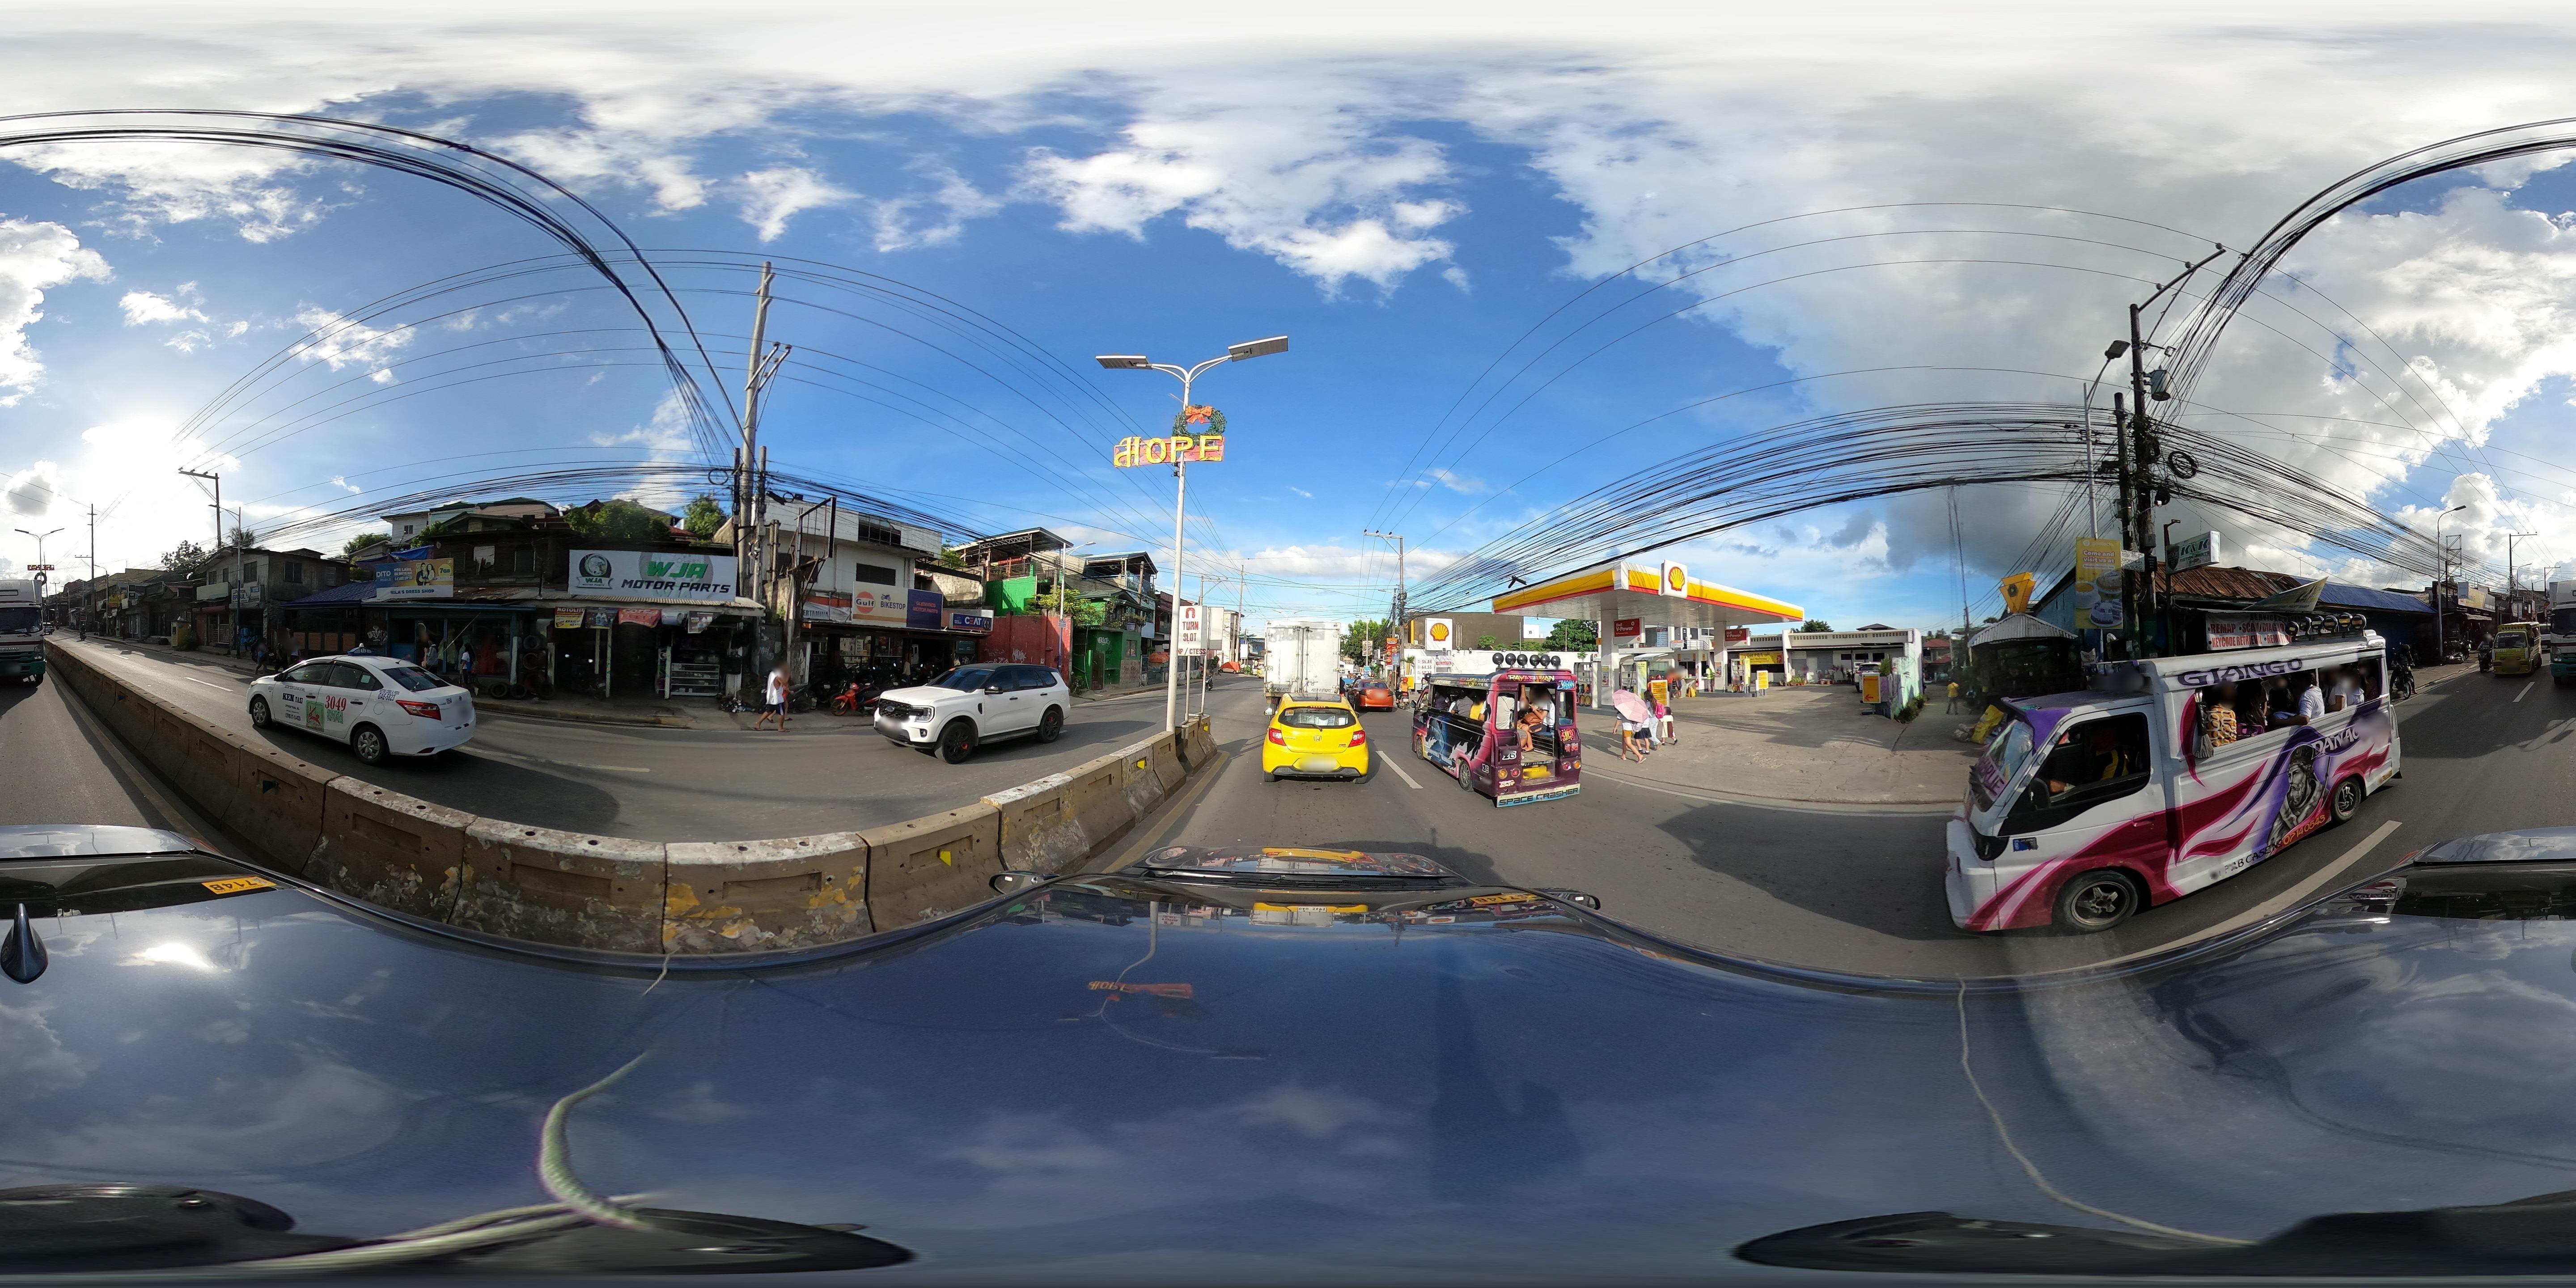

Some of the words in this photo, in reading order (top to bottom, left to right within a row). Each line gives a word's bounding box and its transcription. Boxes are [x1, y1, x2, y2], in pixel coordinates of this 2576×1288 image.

[1114, 435, 1223, 468] HOPE
[648, 561, 708, 579] WJA
[621, 579, 674, 590] MOTOR
[678, 582, 730, 593] PARTS
[880, 602, 906, 610] BIKESTOP
[964, 616, 982, 625] CEAT
[1182, 621, 1199, 631] TURN
[2210, 623, 2236, 633] REMAP
[1183, 633, 1197, 642] SLOT
[2177, 658, 2303, 686] GIANGO
[283, 693, 295, 702] KEN
[325, 695, 347, 712] 3049
[2283, 814, 2326, 846] 07140543
